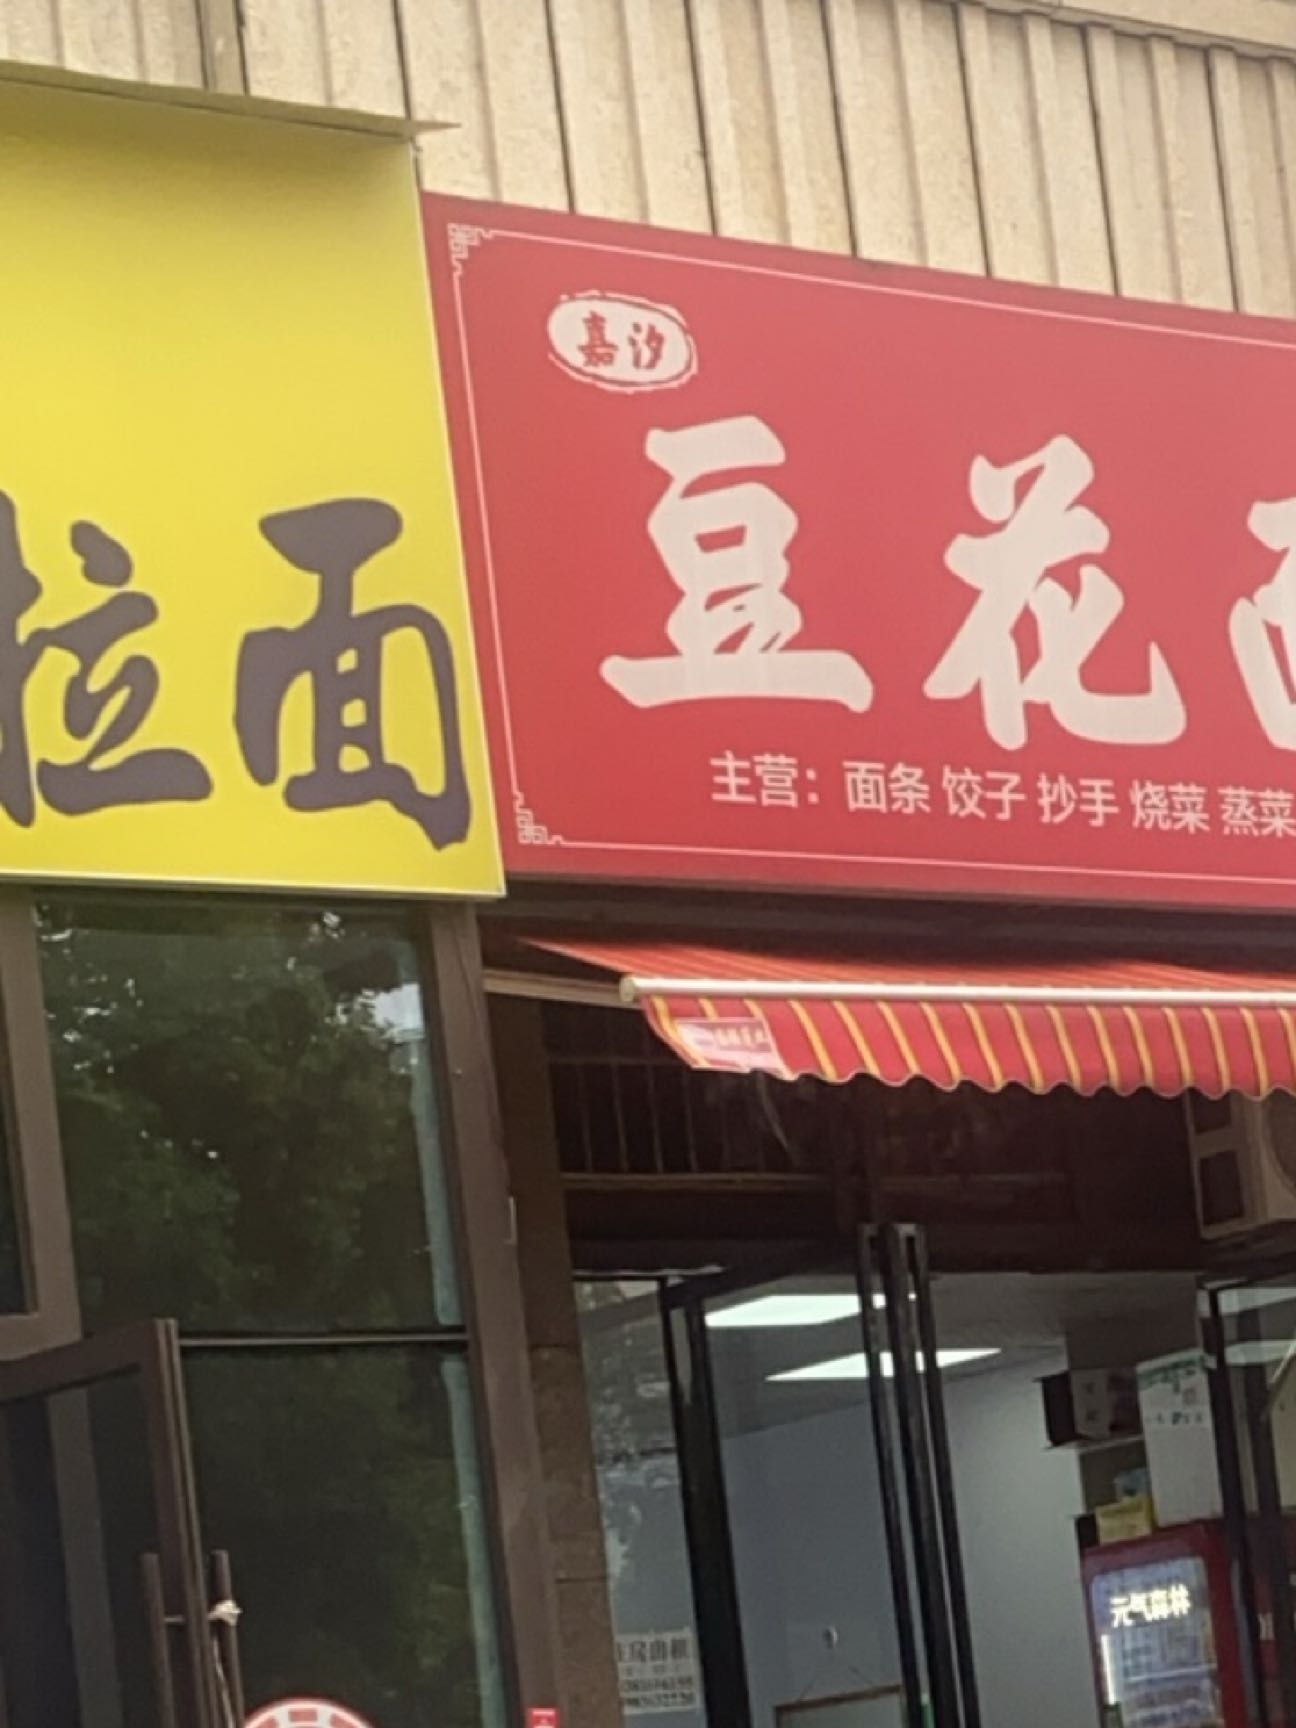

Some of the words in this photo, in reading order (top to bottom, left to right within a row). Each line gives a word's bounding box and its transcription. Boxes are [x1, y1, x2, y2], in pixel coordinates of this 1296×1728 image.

[0, 490, 471, 851] 拉面
[843, 761, 931, 816] 面条
[942, 765, 1027, 822] 饺子
[1037, 772, 1120, 826] 抄手
[1130, 778, 1210, 836] 烧菜
[1109, 1582, 1192, 1629] 元气森林
